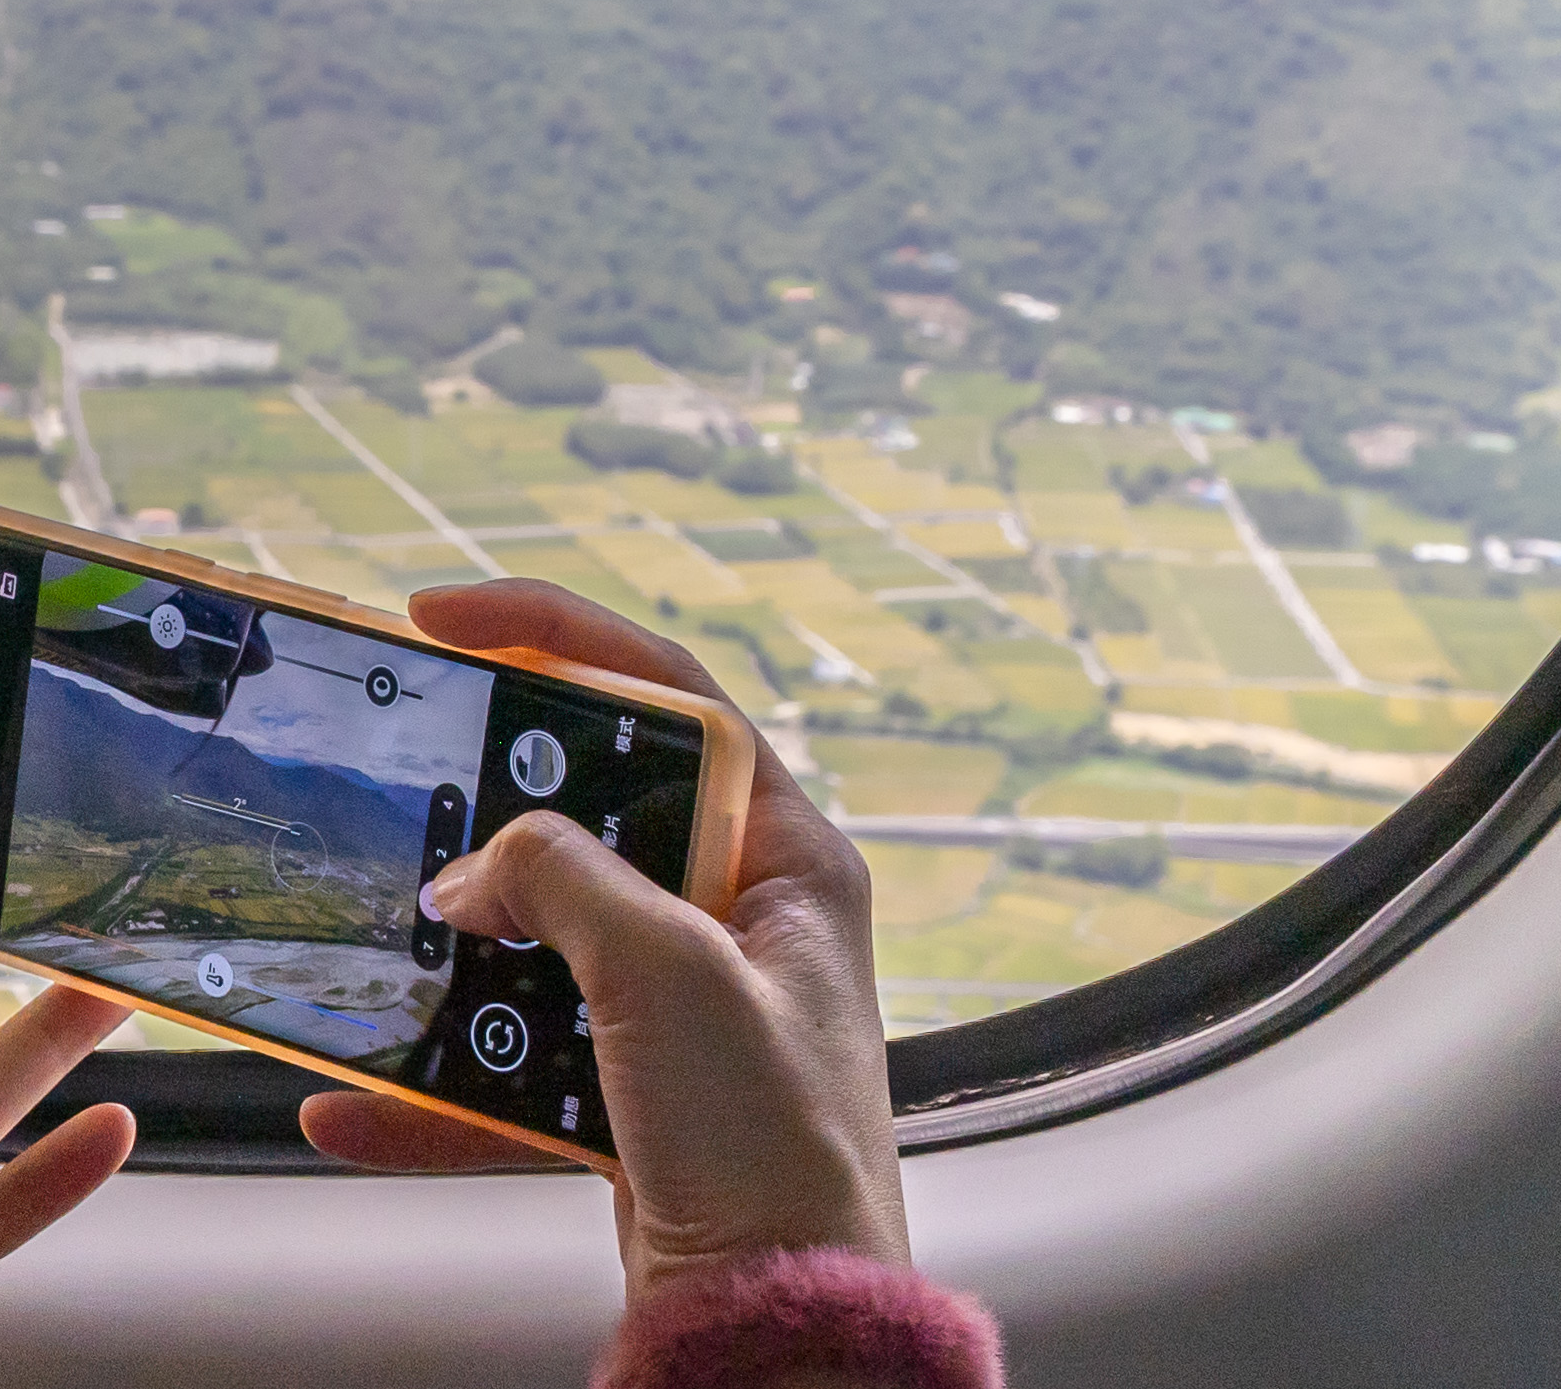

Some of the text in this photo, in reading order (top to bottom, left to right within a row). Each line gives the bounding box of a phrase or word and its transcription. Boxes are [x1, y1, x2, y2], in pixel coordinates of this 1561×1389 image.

[614, 715, 636, 754] 模式
[436, 848, 447, 859] 2
[443, 799, 454, 810] 4
